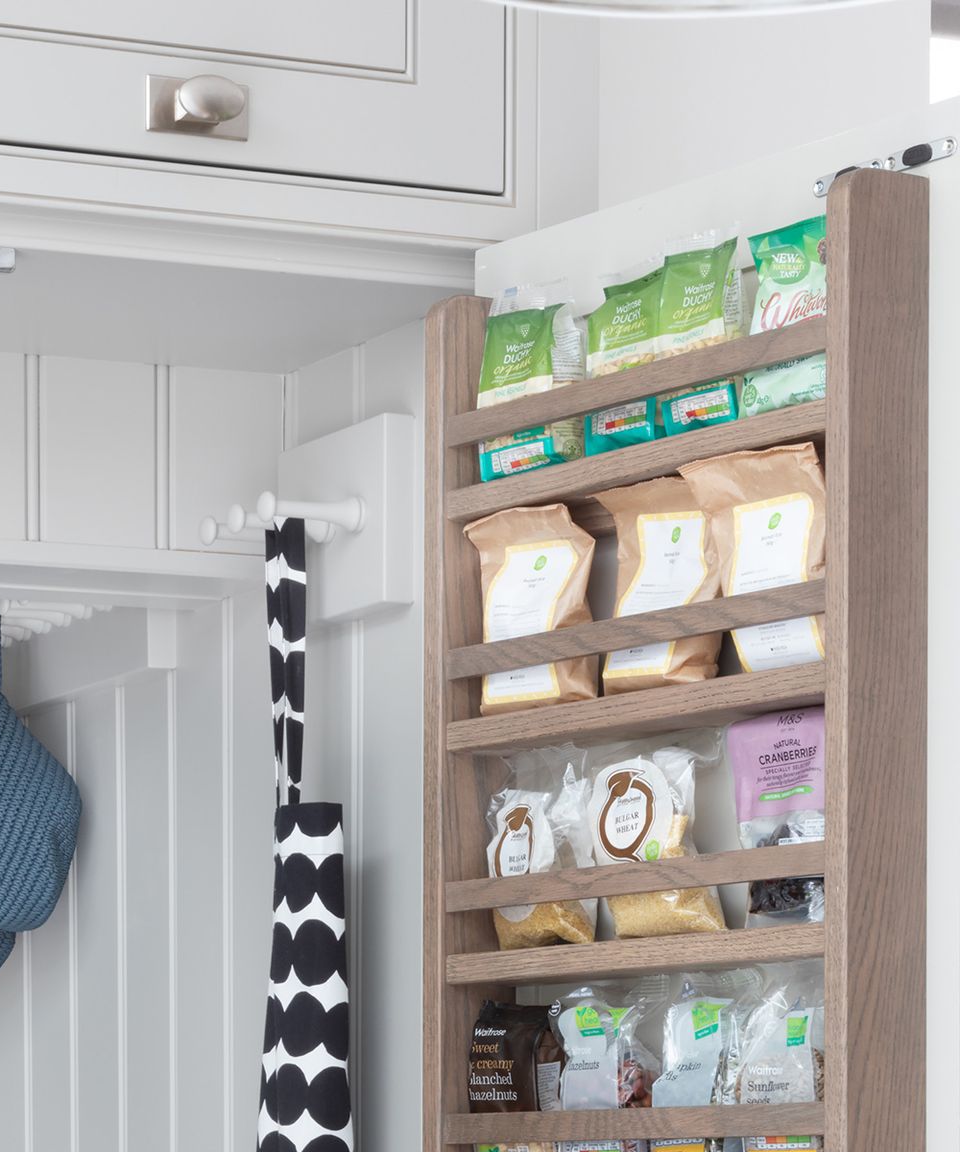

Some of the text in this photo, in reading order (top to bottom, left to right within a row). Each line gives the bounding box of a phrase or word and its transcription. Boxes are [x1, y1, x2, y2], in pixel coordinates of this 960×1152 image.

[777, 712, 804, 726] M&S
[773, 739, 801, 750] NATURAL
[758, 745, 817, 765] CRANBERRIES
[475, 1028, 506, 1036] Waitrose
[477, 1060, 514, 1072] creamy
[747, 1080, 789, 1092] Sunflower
[469, 1088, 518, 1101] hazelnuts
